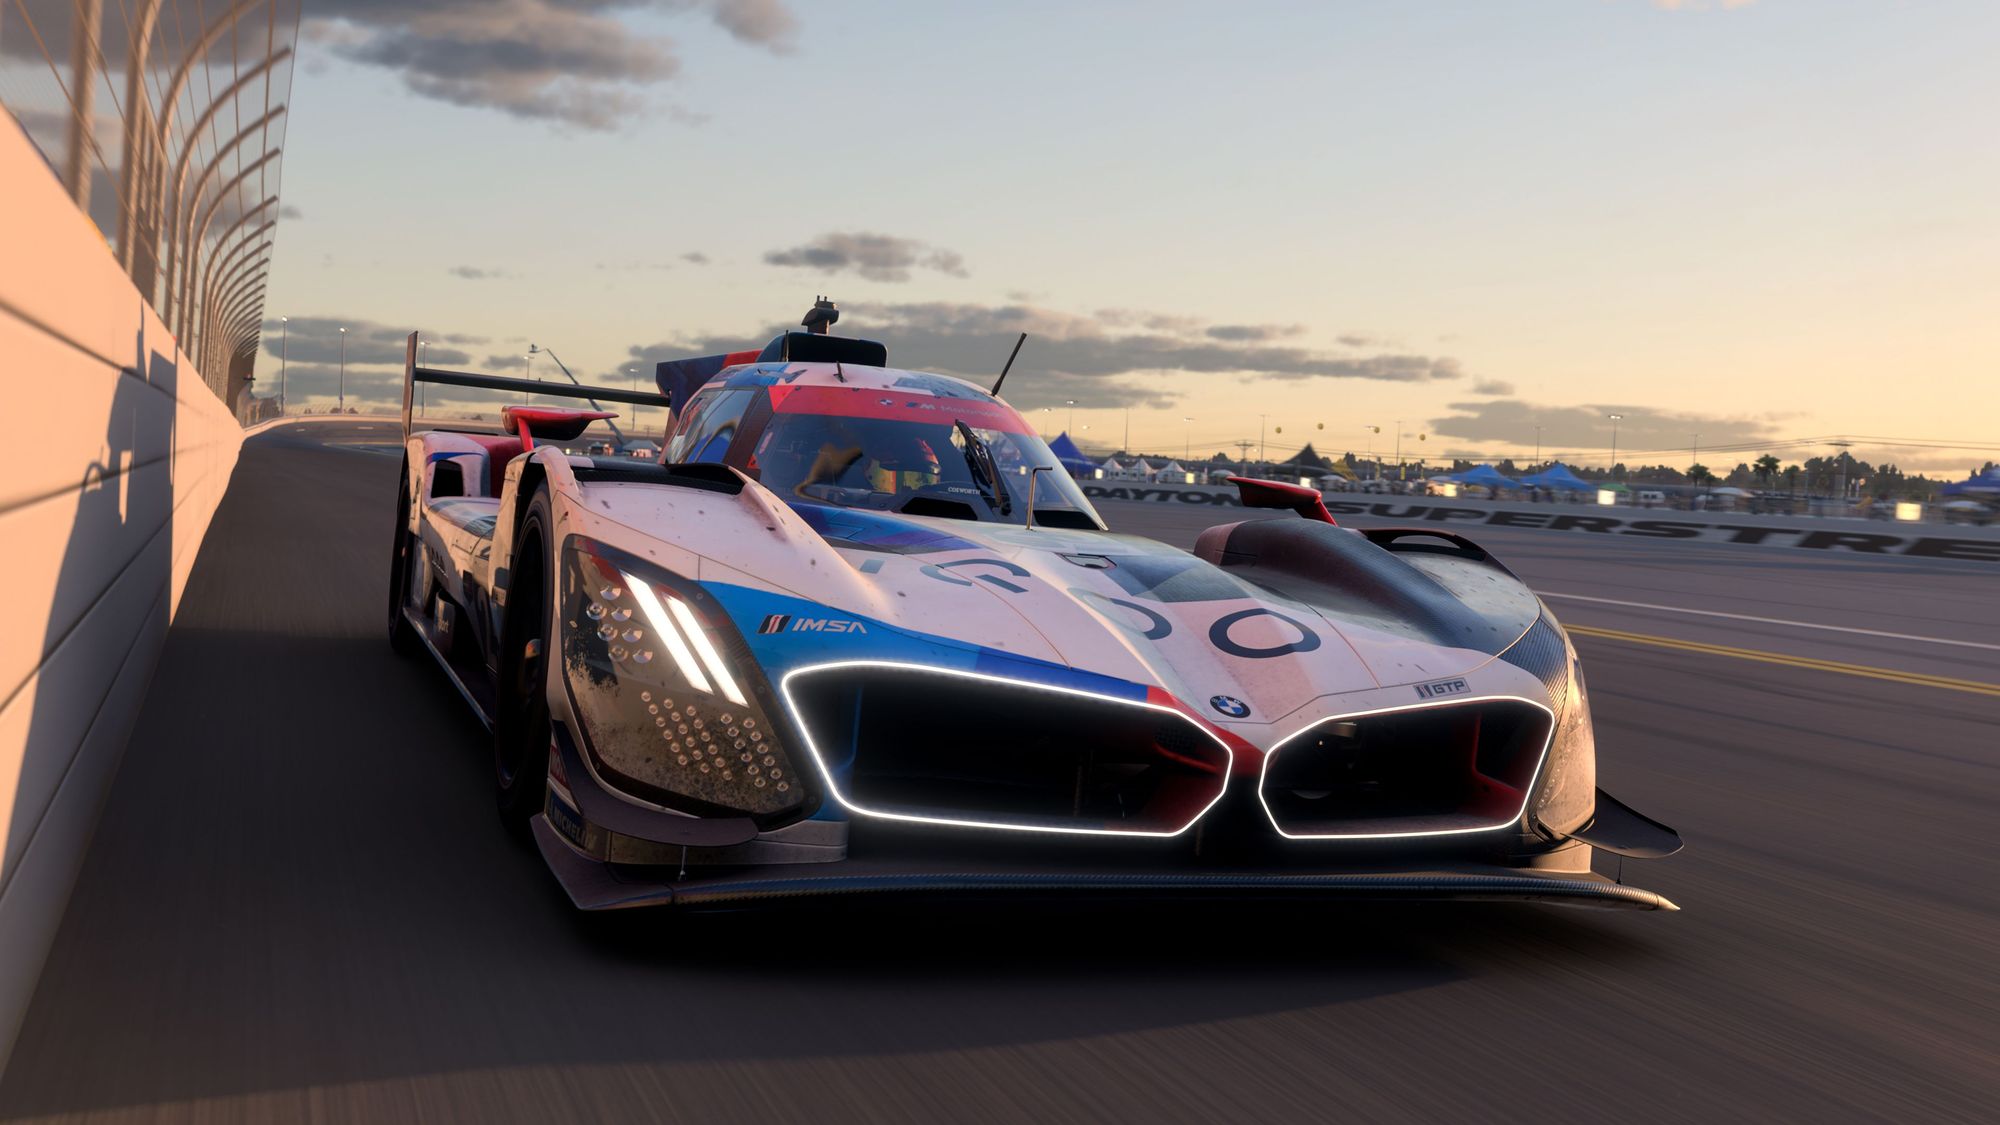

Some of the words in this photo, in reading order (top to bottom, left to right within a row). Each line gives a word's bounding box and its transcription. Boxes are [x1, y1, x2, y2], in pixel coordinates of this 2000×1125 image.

[1083, 485, 1245, 507] DAYTON
[792, 617, 868, 634] IMSA
[1432, 680, 1465, 695] GTP
